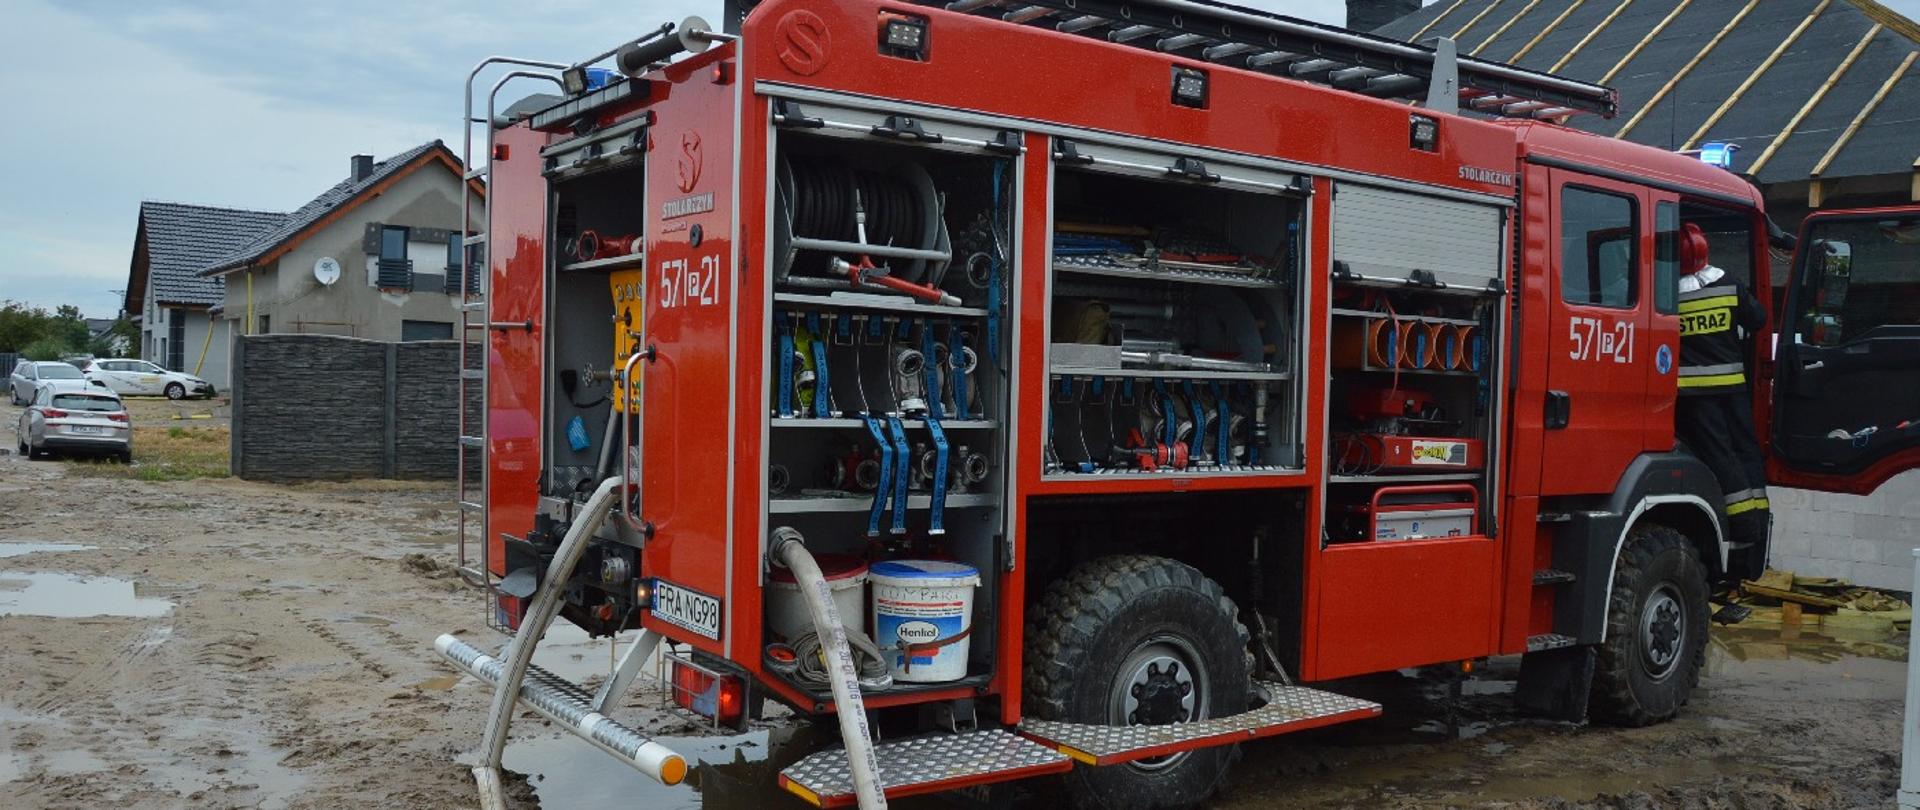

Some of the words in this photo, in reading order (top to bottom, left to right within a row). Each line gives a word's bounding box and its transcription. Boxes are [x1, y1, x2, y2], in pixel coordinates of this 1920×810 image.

[1458, 166, 1511, 186] STOLARCZYK
[661, 193, 714, 219] STOLARCZYK
[660, 584, 682, 617] FRA
[686, 594, 716, 629] NG98
[900, 628, 936, 637] Henkel
